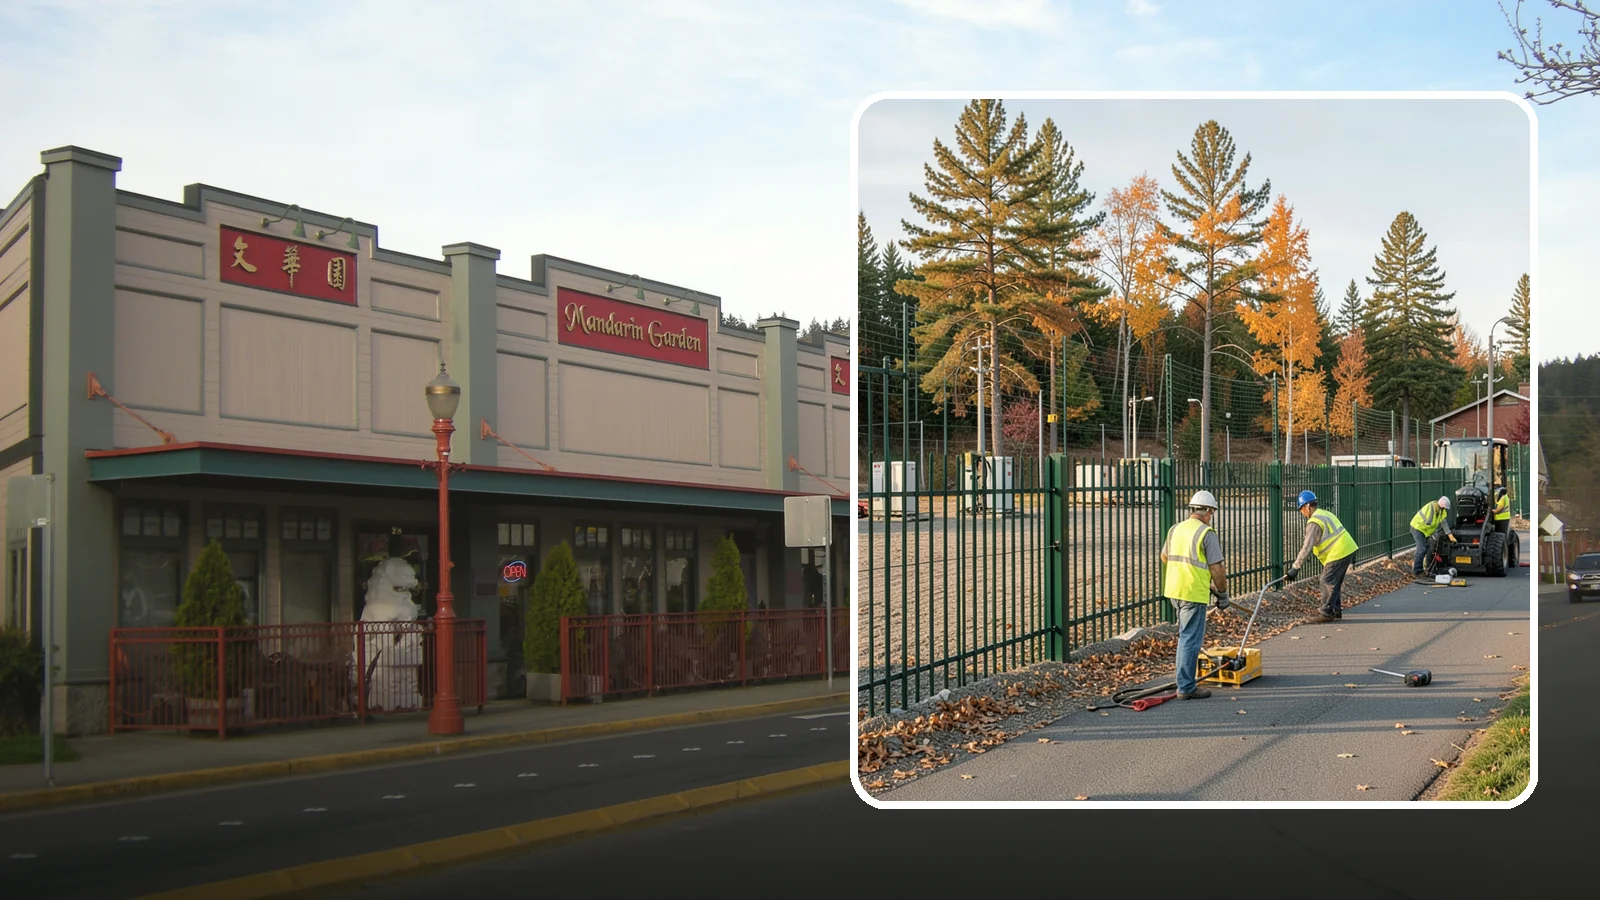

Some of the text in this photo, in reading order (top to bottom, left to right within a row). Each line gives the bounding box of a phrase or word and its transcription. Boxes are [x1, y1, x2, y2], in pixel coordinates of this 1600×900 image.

[231, 236, 346, 290] 文華園
[564, 302, 701, 352] Mandarin Garden
[503, 565, 526, 578] OPEN
